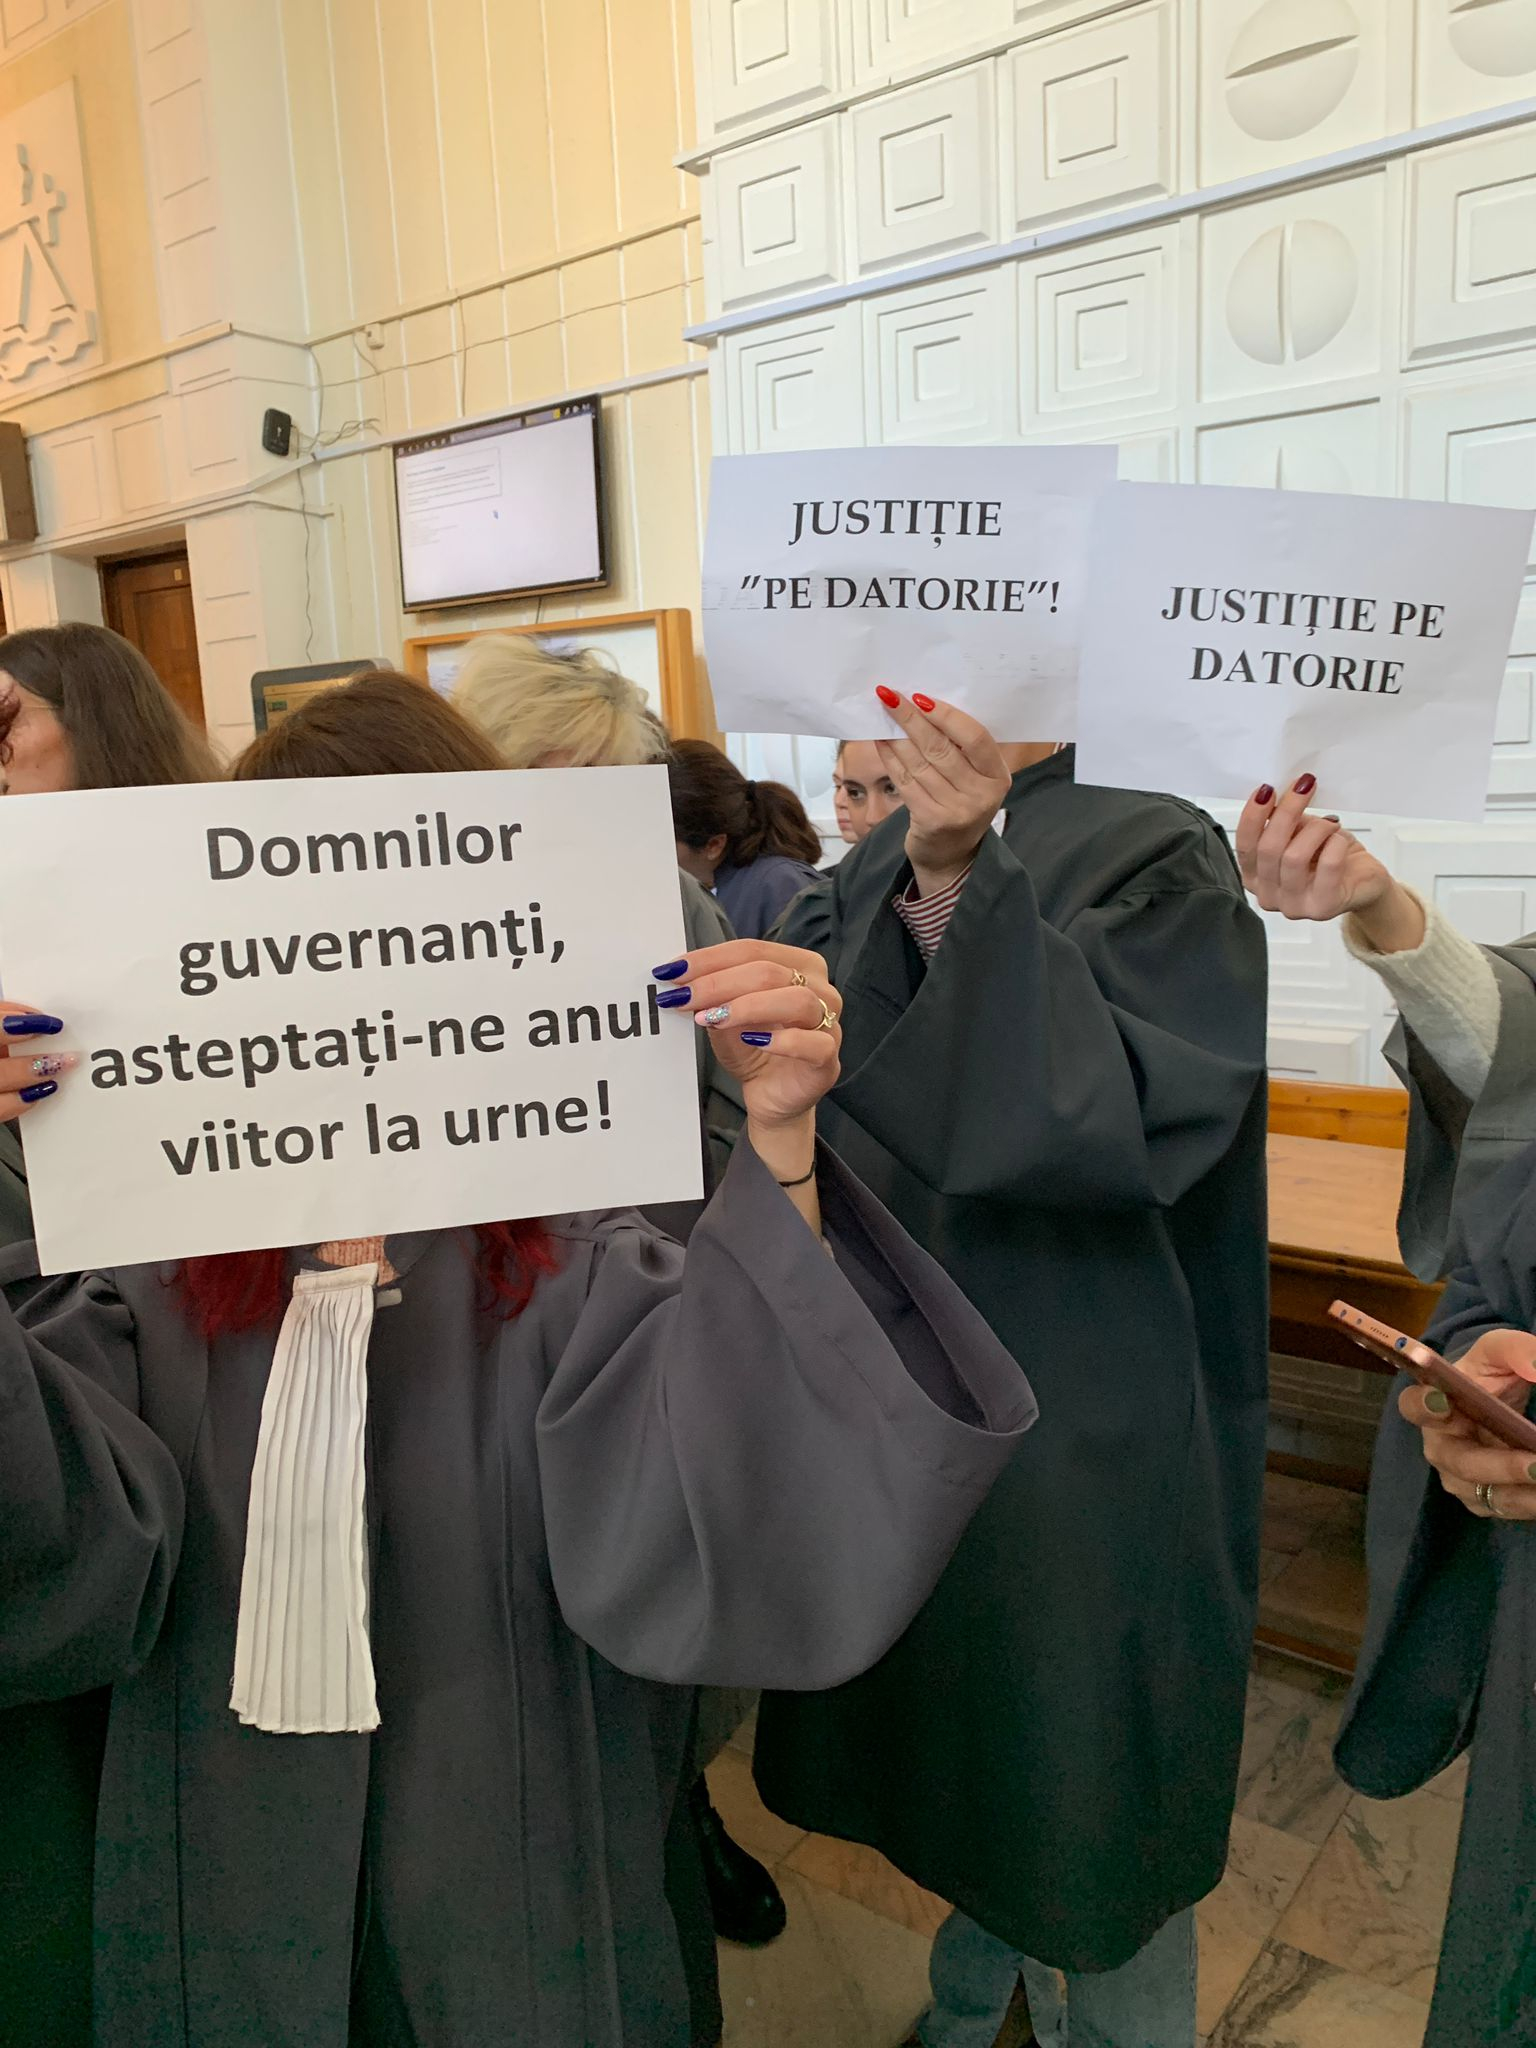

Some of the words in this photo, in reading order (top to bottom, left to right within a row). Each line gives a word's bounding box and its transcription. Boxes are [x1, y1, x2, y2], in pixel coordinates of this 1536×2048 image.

[788, 499, 1001, 548] JUSTIȚIE
[1161, 586, 1376, 636] JUSTIȚIE
[1389, 600, 1445, 639] PE
[1188, 647, 1405, 695] DATORIE
[206, 811, 522, 880] Domnilor
[178, 902, 565, 996] guvernanți,
[90, 1009, 505, 1089] asteptați-ne
[527, 984, 661, 1048] anul
[160, 1119, 344, 1176] viitor
[366, 1103, 421, 1155] la
[444, 1079, 612, 1147] urne!
